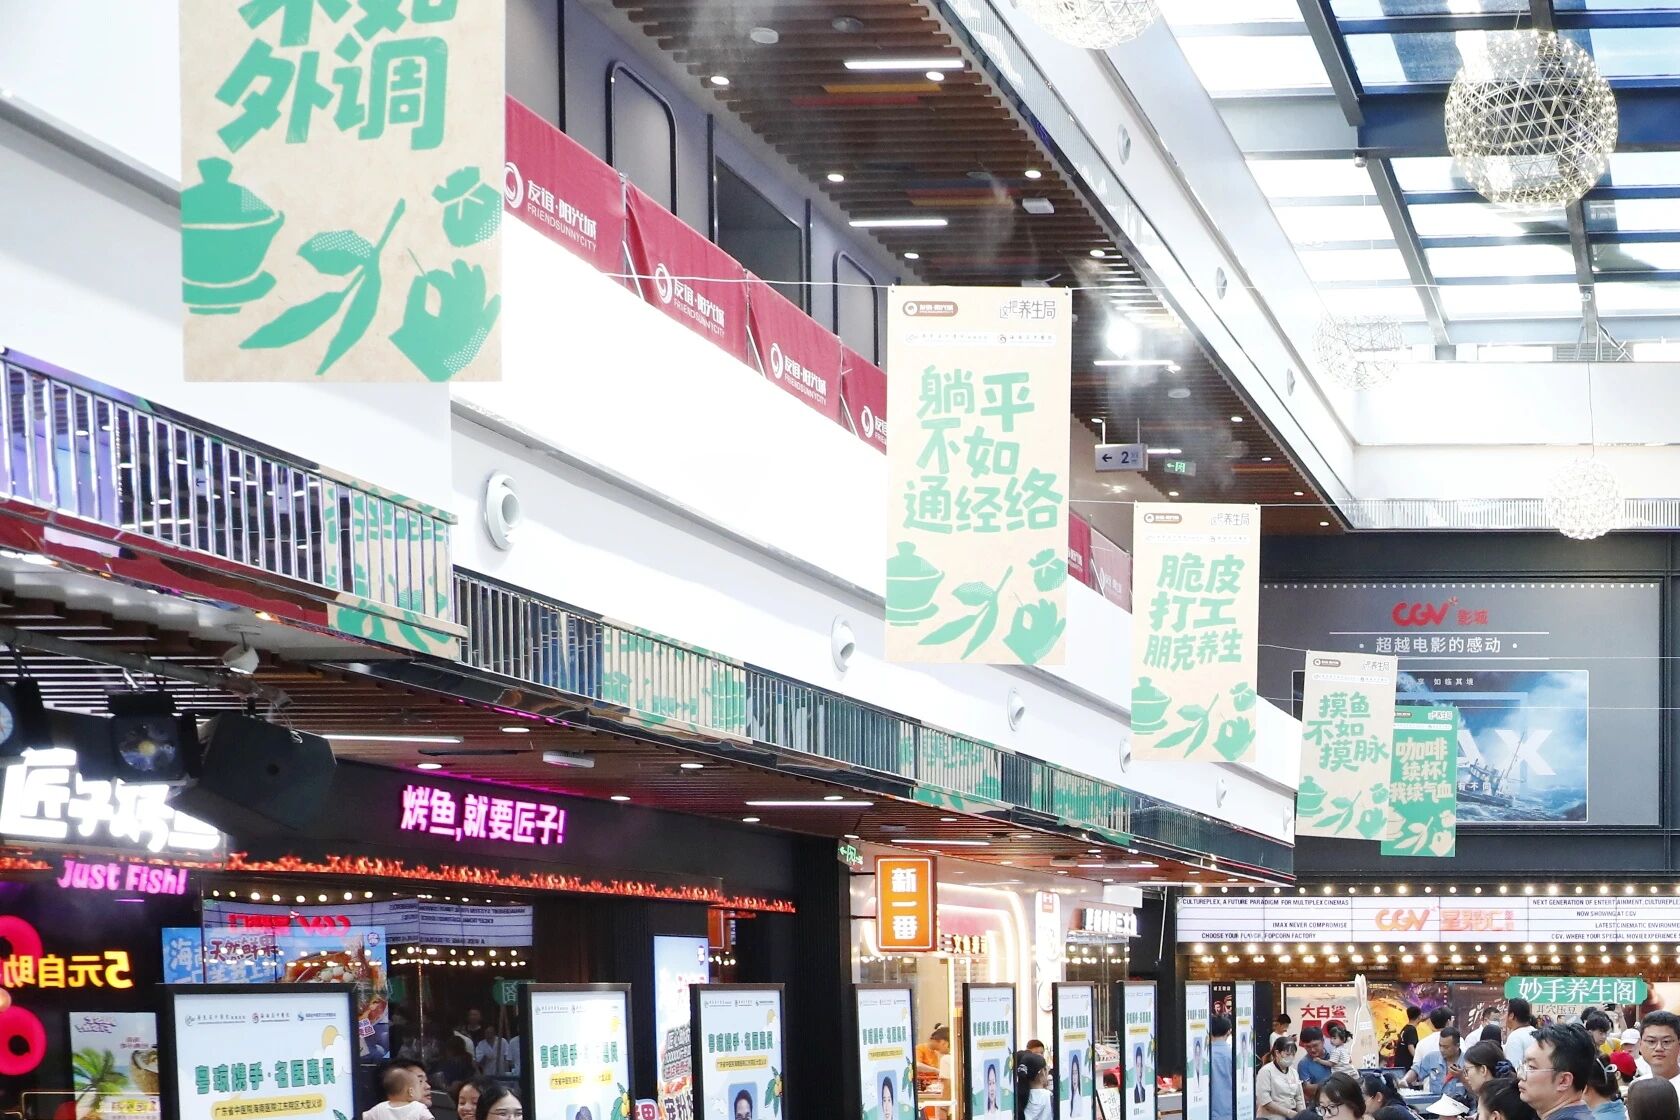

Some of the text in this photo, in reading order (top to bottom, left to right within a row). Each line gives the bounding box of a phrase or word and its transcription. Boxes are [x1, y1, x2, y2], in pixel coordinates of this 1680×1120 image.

[215, 36, 450, 152] 外调
[527, 180, 597, 240] 友谊·阳光城
[527, 202, 597, 252] FRIENDSUNNYCITY
[916, 364, 1035, 433] 躺平
[916, 417, 1021, 479] 不如
[1121, 451, 1129, 463] 2
[903, 467, 1064, 535] 通经络
[1156, 552, 1245, 594] 脆皮
[1149, 592, 1237, 631] 打工
[1392, 600, 1450, 627] CGV
[1142, 629, 1244, 672] 朋克养生
[1375, 636, 1501, 654] 超越电影的感动
[1433, 678, 1474, 686] 如临其境
[1318, 691, 1371, 721] 摸鱼
[1303, 720, 1365, 746] 不如
[1318, 734, 1389, 773] 摸脉
[1395, 736, 1448, 764] 咖啡
[1457, 729, 1556, 777] AX
[1402, 760, 1448, 781] 续杯!
[1457, 782, 1492, 791] 有不同
[1375, 907, 1430, 931] CGV
[1518, 978, 1637, 1003] 妙手养生阁
[1300, 1004, 1347, 1019] 大白鲨
